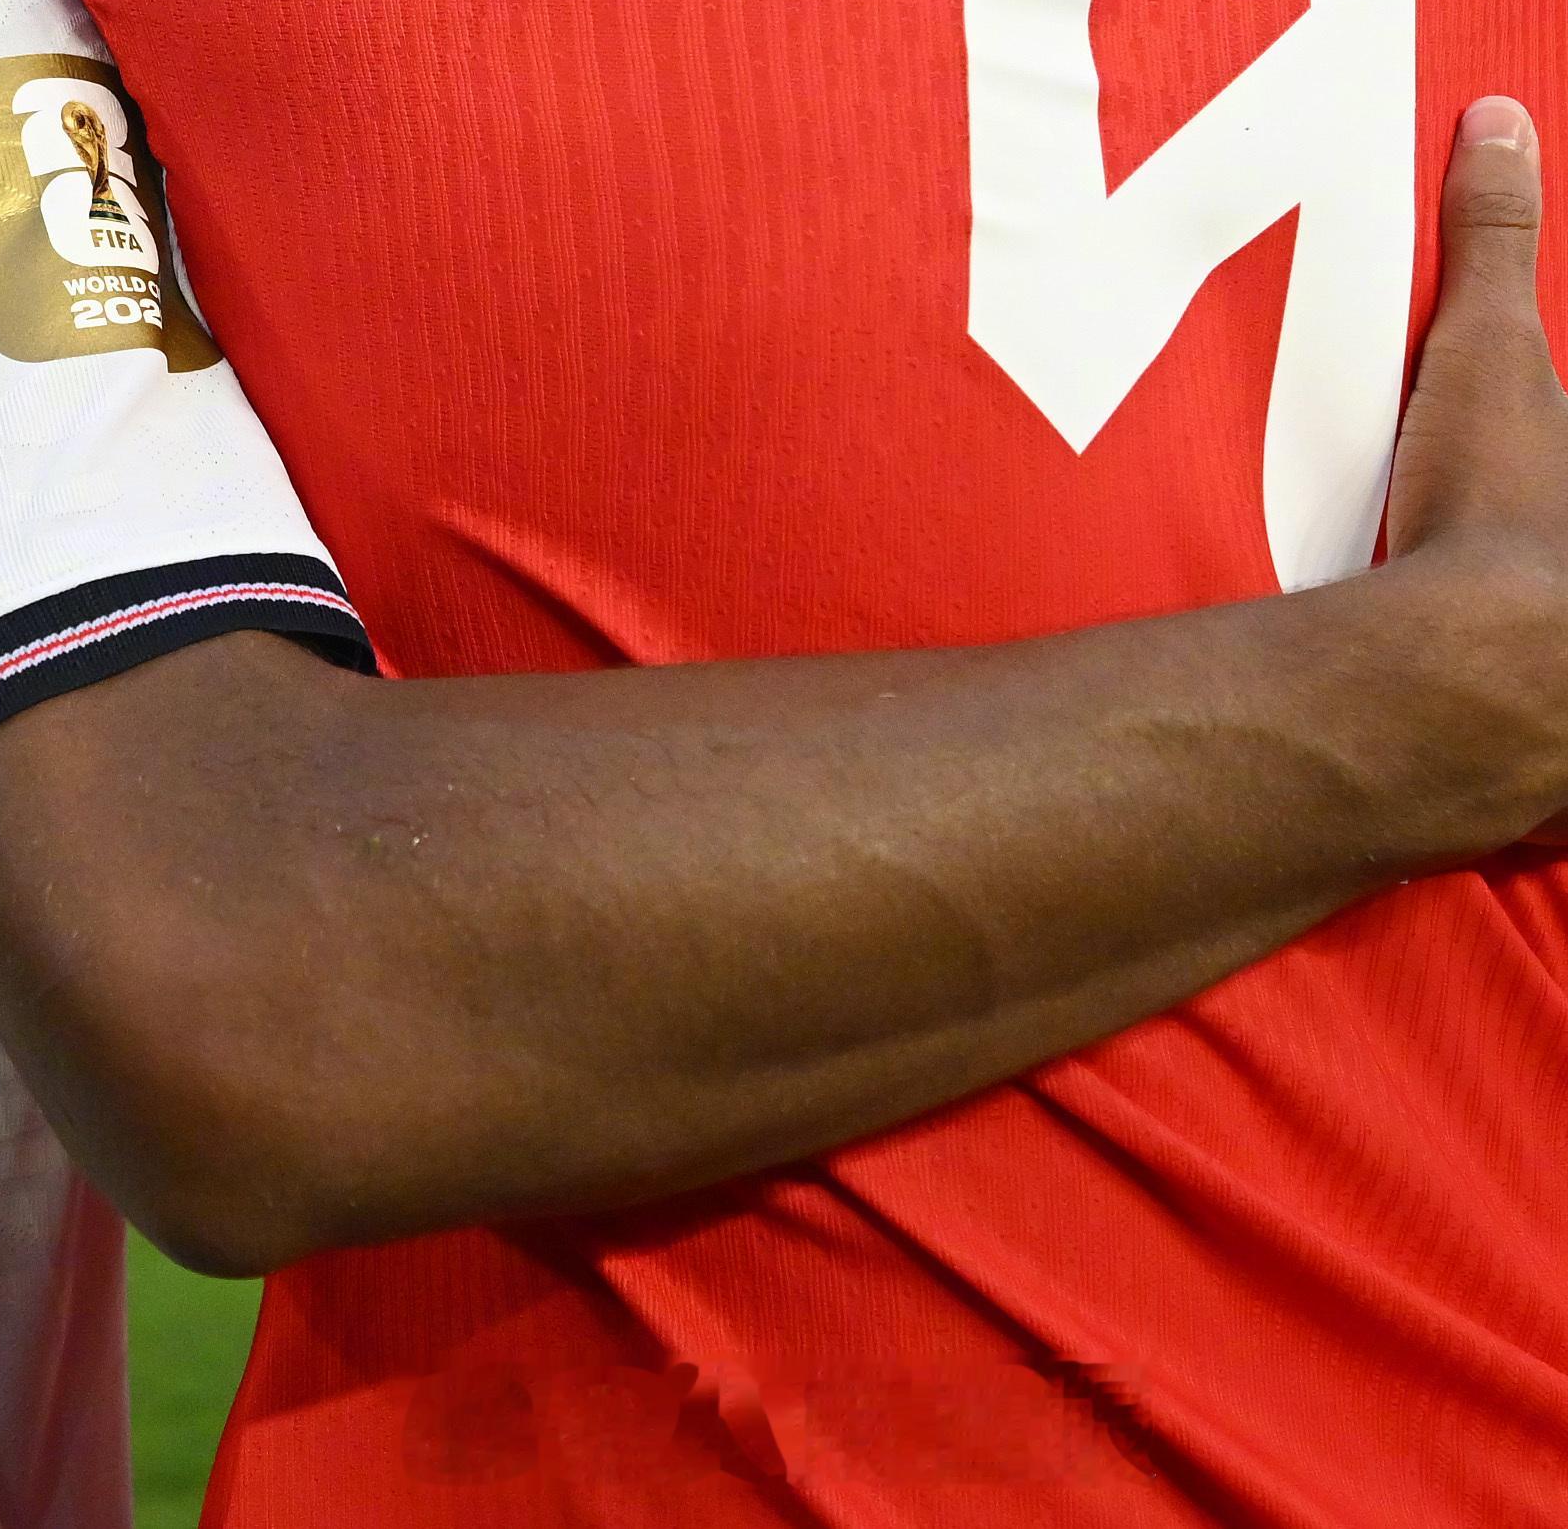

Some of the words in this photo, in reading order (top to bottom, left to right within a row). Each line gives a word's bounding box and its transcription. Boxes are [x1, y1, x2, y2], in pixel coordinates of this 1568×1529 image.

[89, 228, 144, 254] FIFA
[62, 275, 147, 297] WORLD
[70, 296, 164, 331] 202
